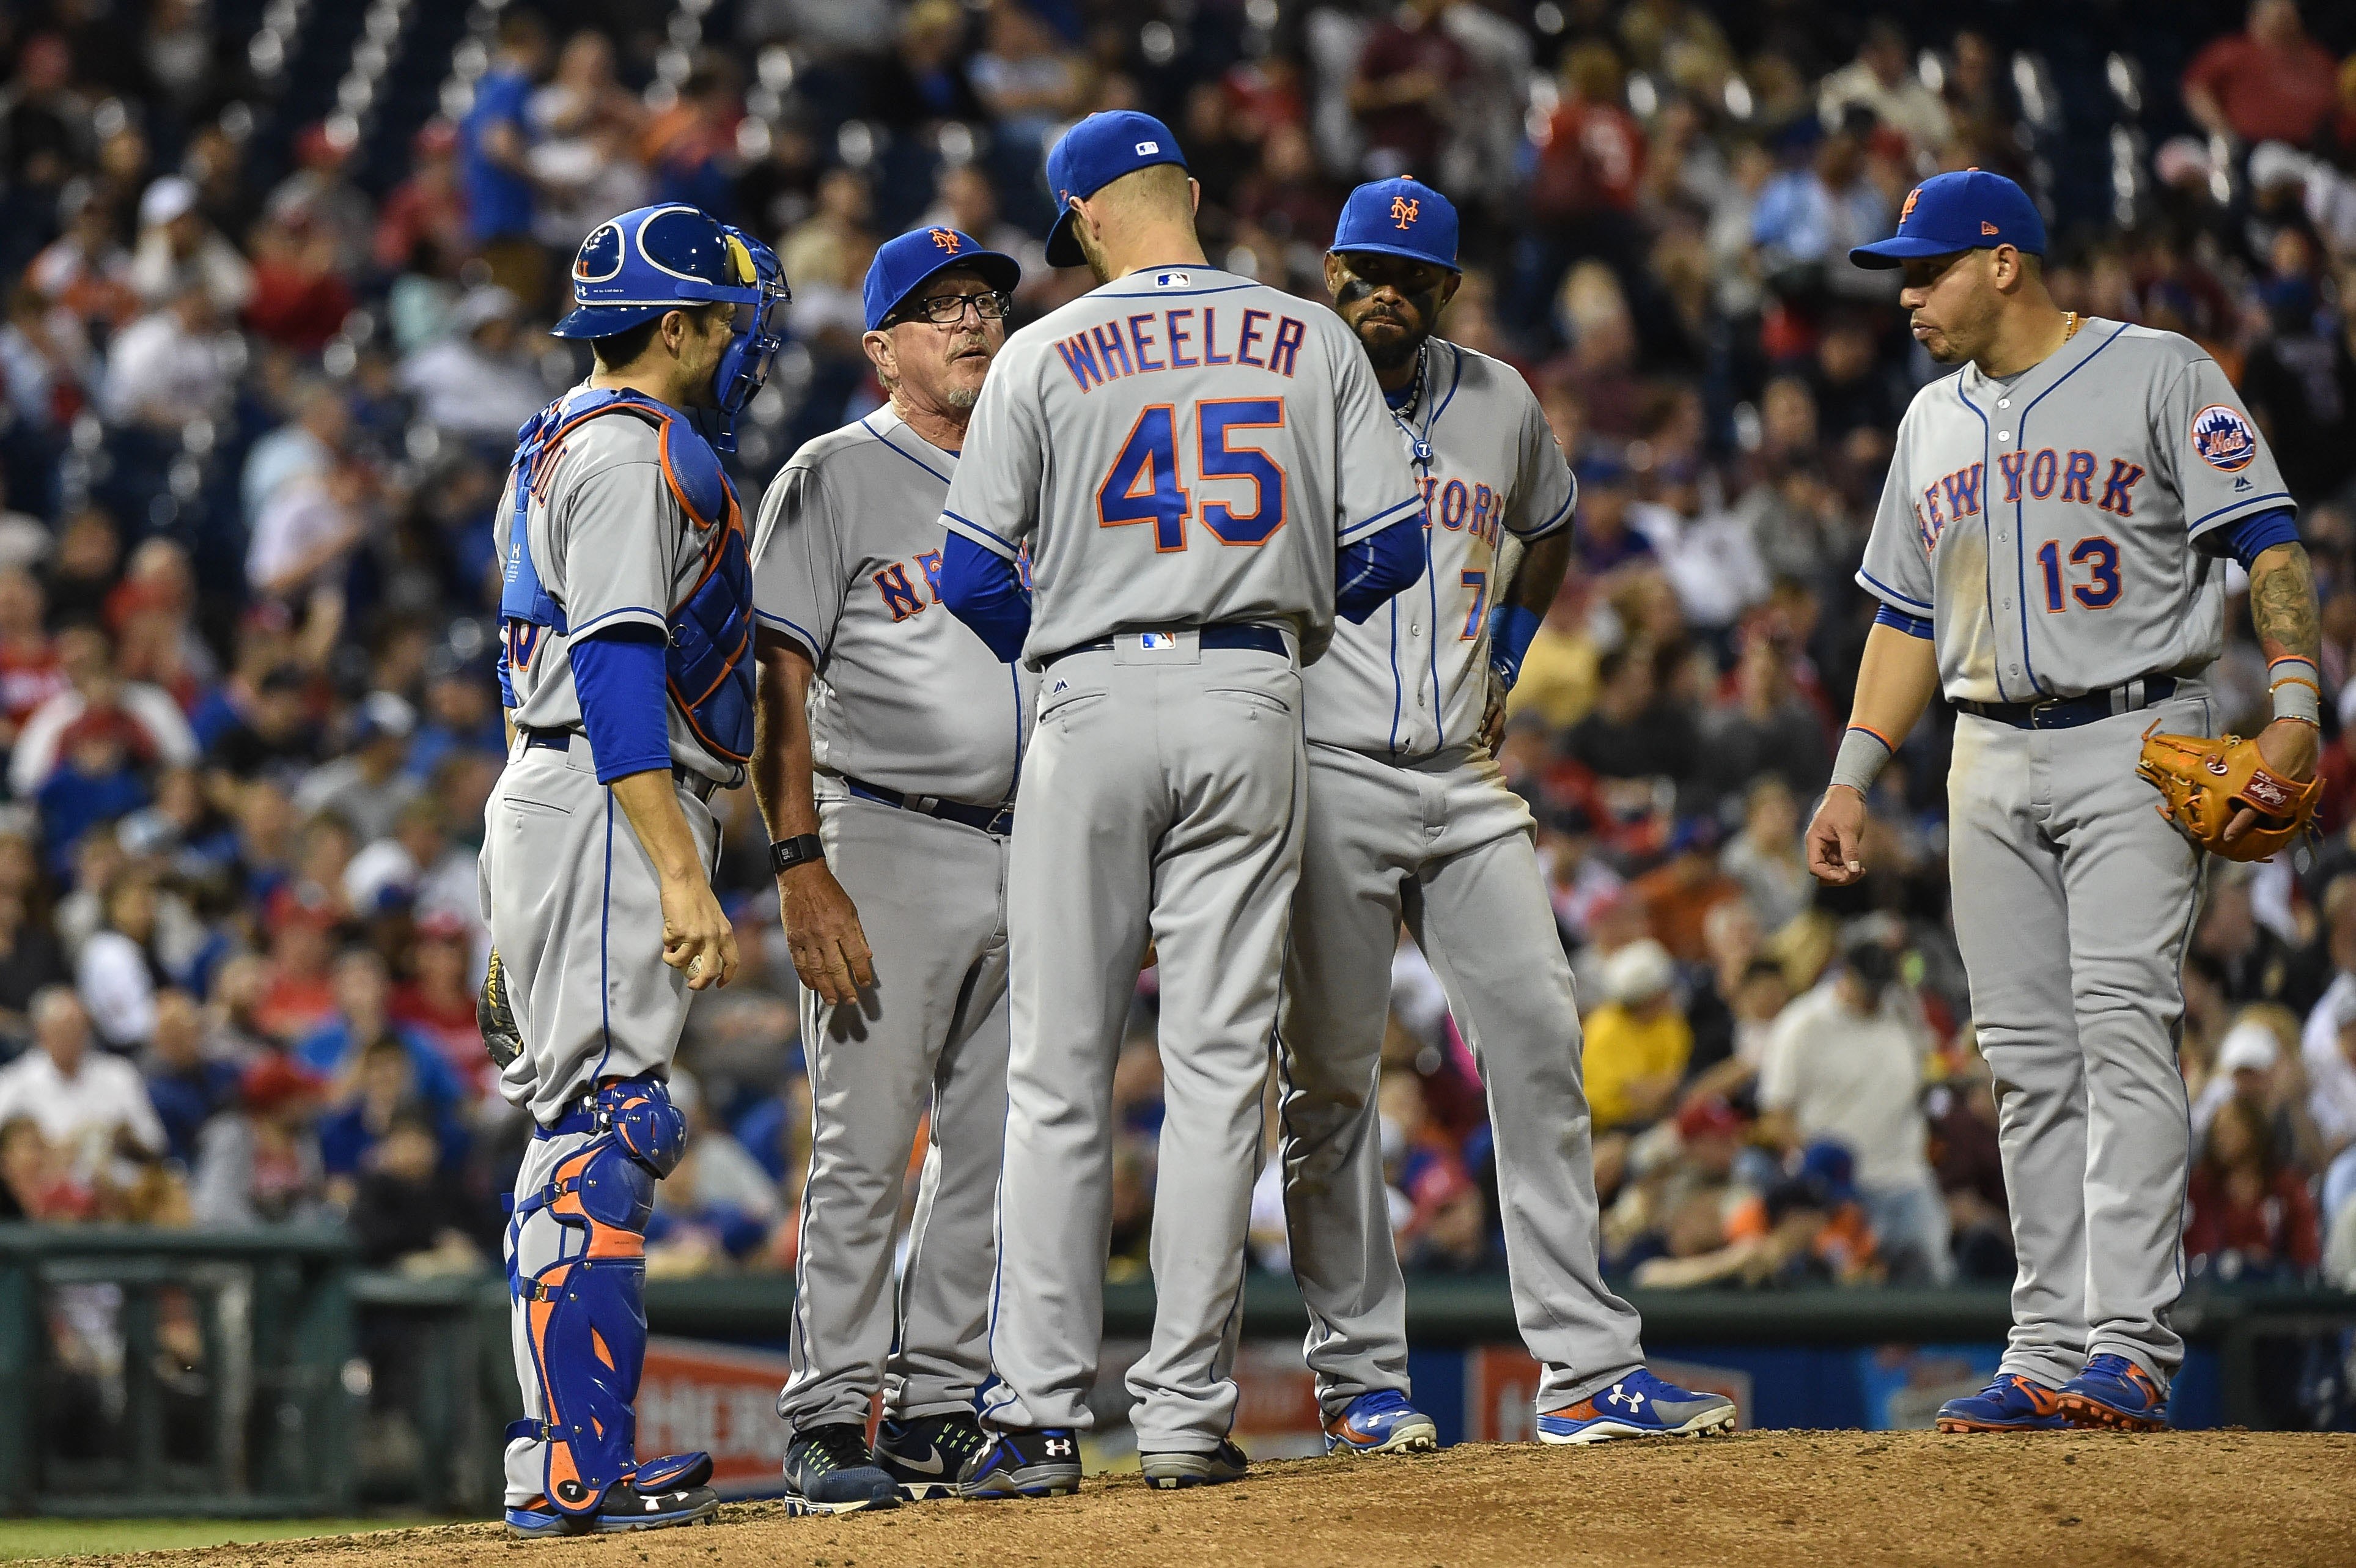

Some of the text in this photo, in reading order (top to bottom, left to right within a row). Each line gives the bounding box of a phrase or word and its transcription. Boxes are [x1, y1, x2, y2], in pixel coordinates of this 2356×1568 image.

[929, 228, 962, 254] NY
[1390, 196, 1419, 230] NY
[1053, 307, 1307, 394] WHEELER
[1095, 396, 1287, 553] 45
[1418, 444, 1427, 456] 7
[2205, 429, 2246, 456] Mets
[1998, 447, 2146, 518] YORK
[872, 548, 944, 623] NE
[1459, 568, 1486, 640] 7
[2036, 536, 2122, 614] 13
[566, 1484, 578, 1495] 7
